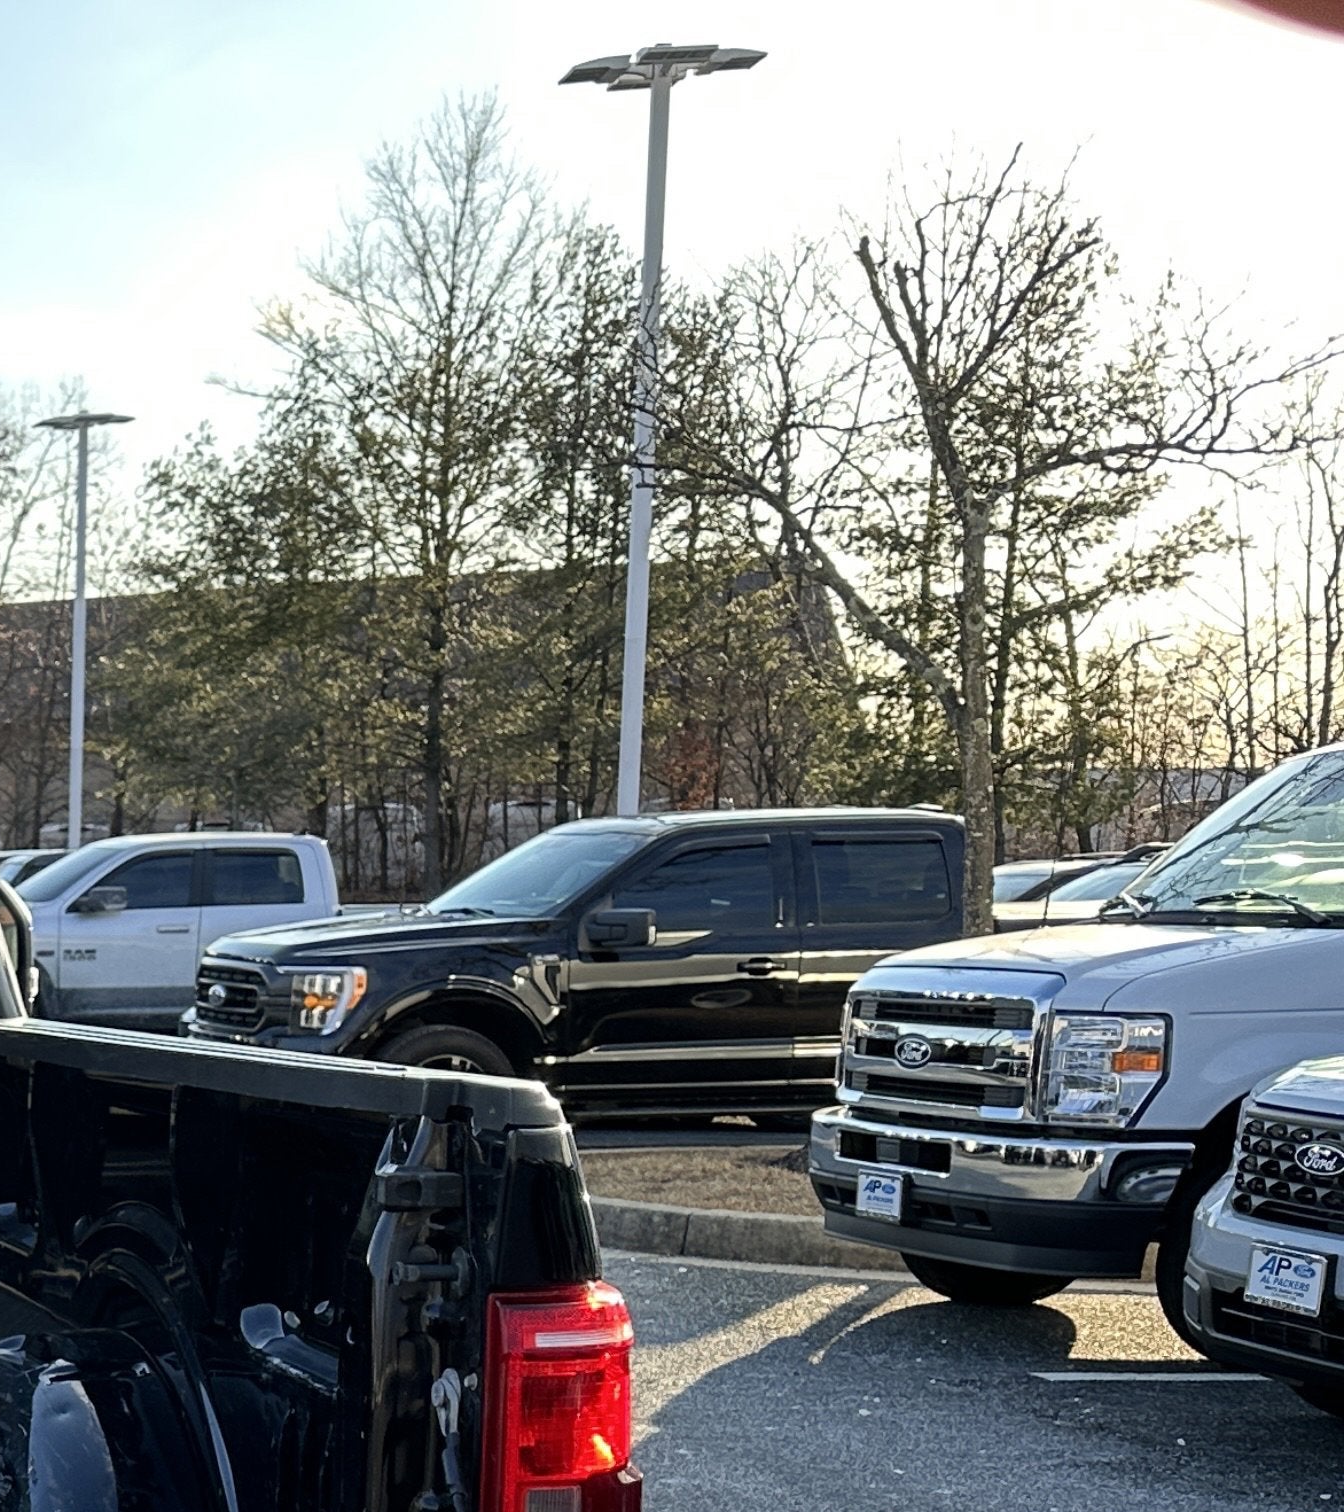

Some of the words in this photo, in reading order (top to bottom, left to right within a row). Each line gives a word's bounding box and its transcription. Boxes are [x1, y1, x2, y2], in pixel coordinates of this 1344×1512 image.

[1304, 1146, 1337, 1171] Ford
[863, 1180, 882, 1193] AP
[1257, 1255, 1292, 1276] AP
[1273, 1277, 1310, 1291] PACKERS
